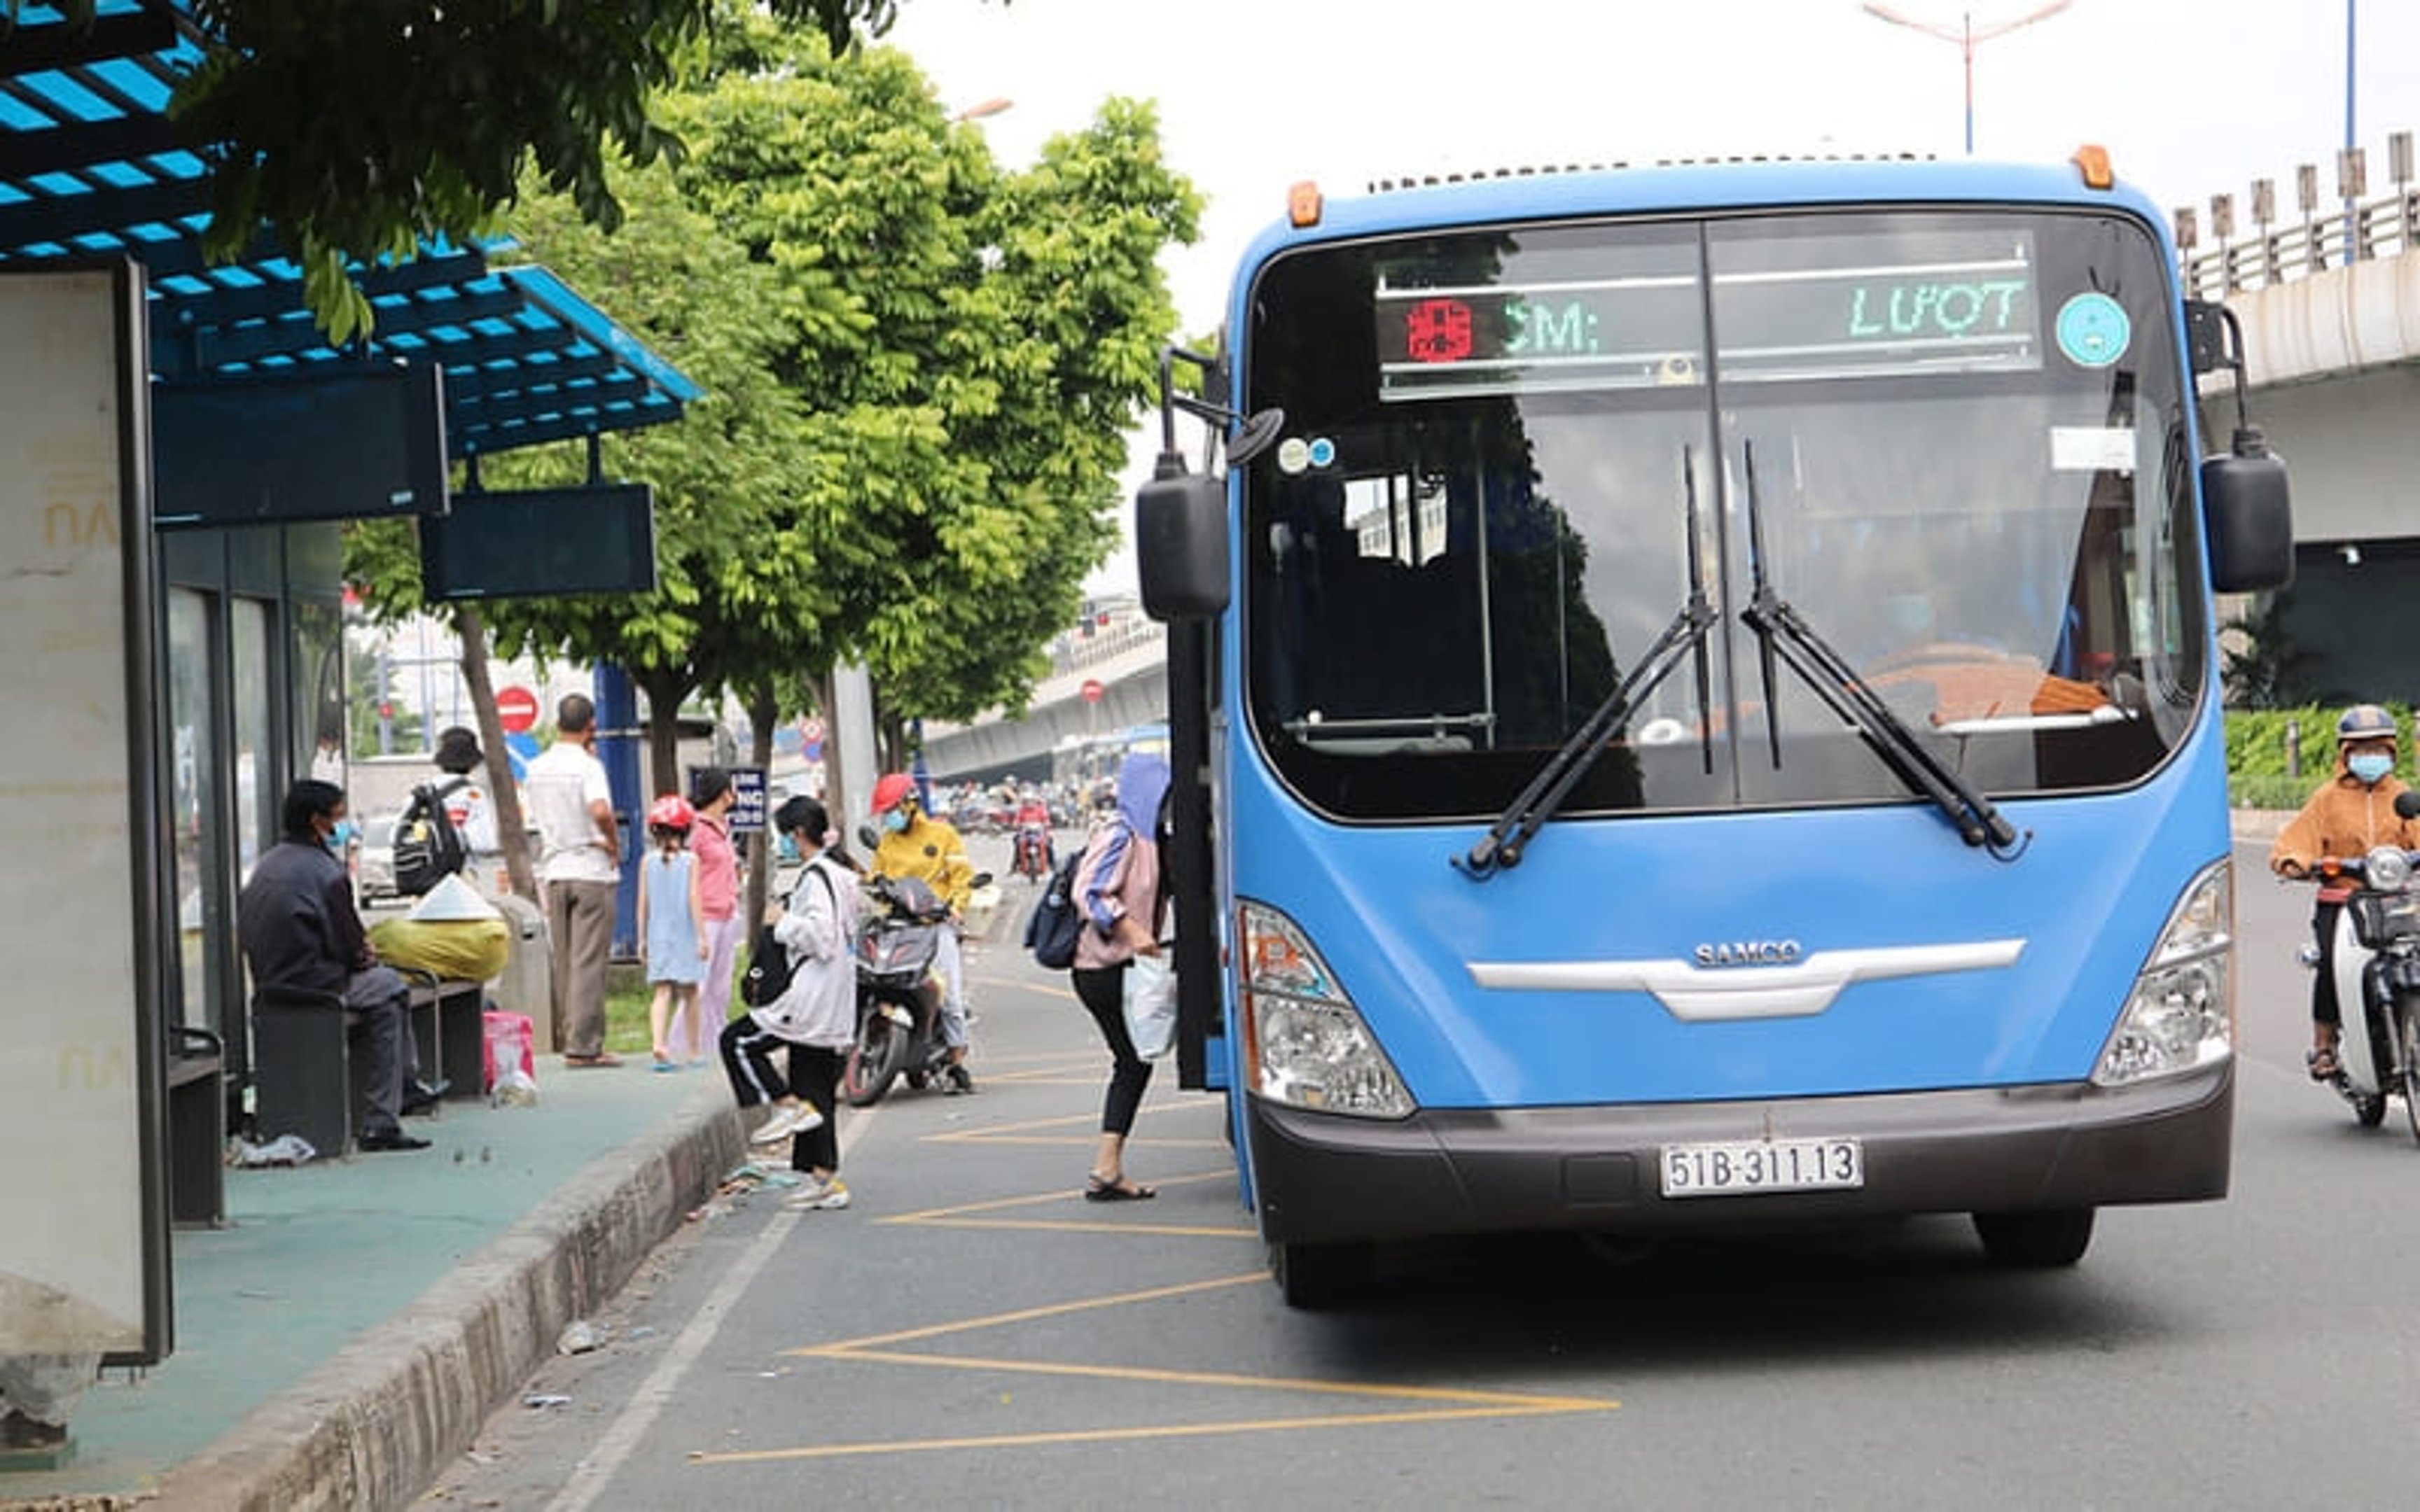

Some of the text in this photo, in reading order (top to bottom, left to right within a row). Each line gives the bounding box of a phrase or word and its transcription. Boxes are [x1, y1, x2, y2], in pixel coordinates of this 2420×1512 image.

[1850, 281, 2026, 340] LƯỢT
[1694, 939, 1800, 966] SAMCO
[1668, 1145, 1855, 1186] 51B-311.13
